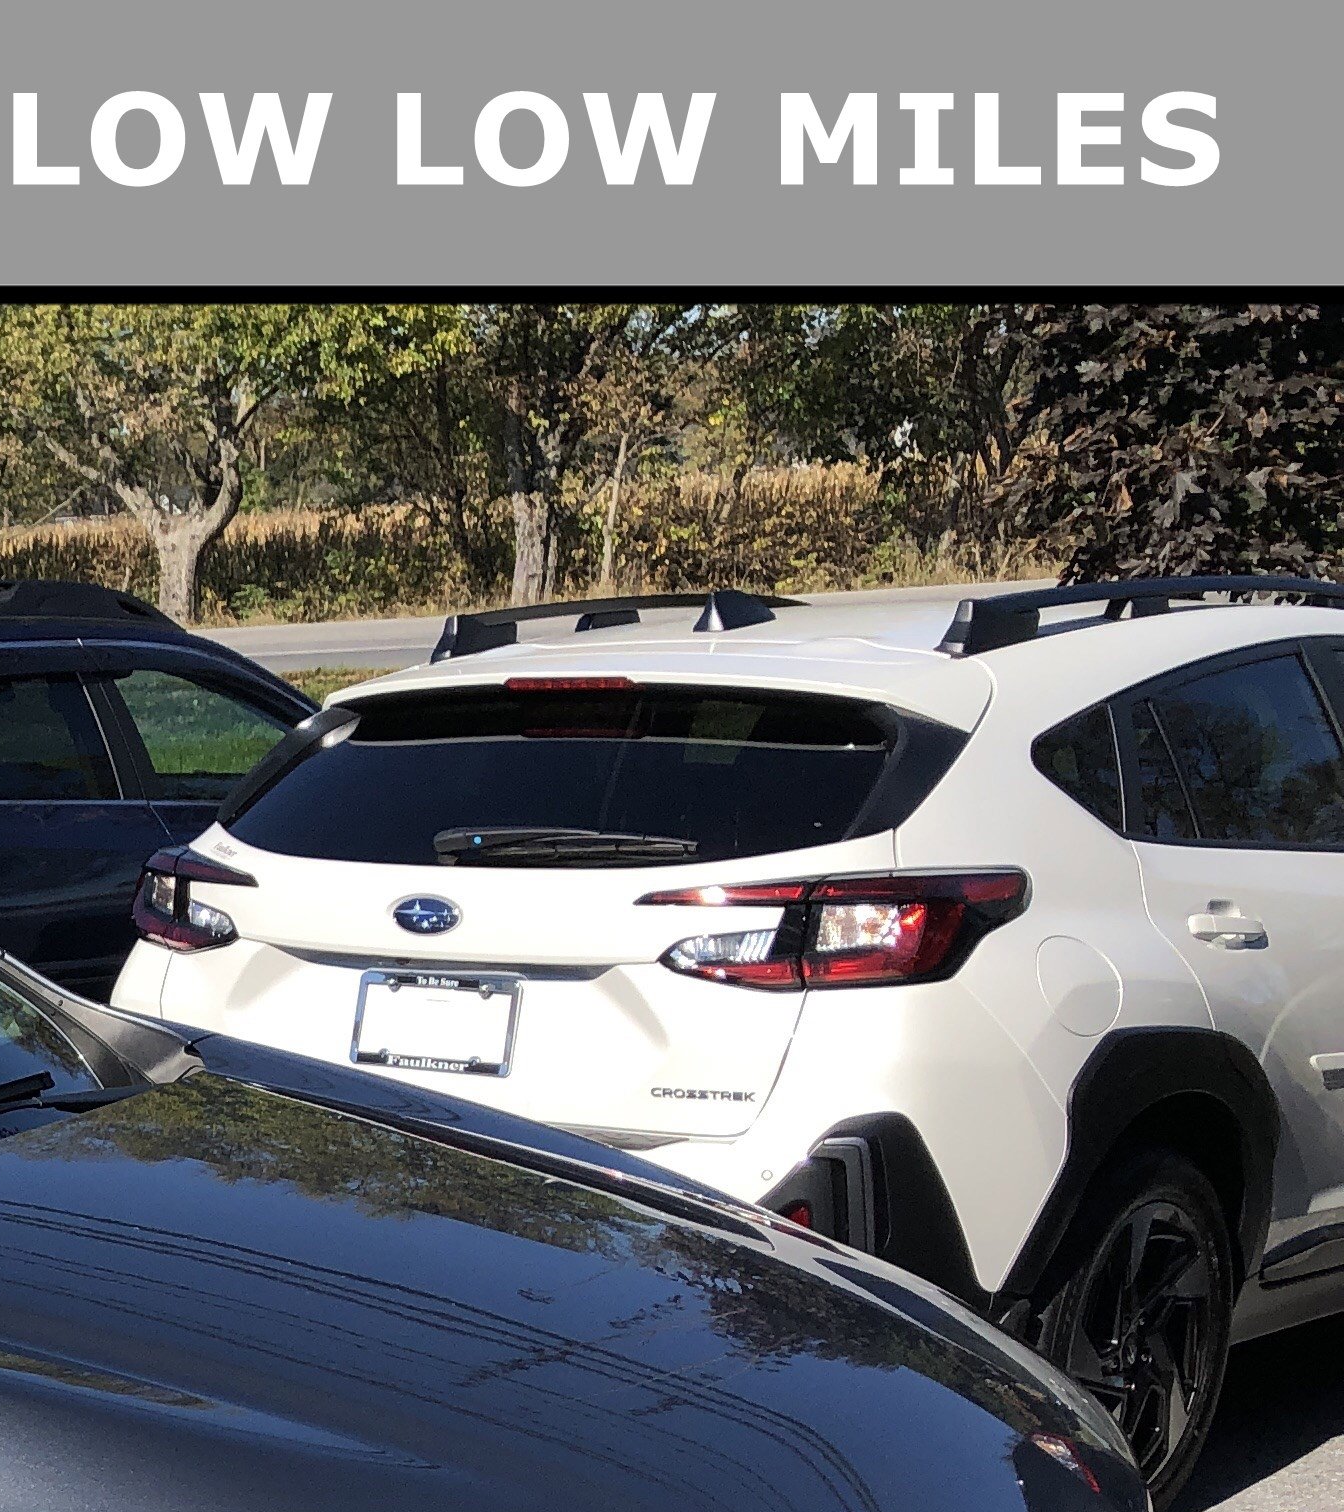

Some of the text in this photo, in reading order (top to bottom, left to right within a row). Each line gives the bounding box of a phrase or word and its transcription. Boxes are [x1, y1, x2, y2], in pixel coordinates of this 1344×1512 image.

[416, 975, 460, 988] To Be Sure
[386, 1054, 470, 1072] Faulkner
[650, 1086, 757, 1103] CROSSTREK
